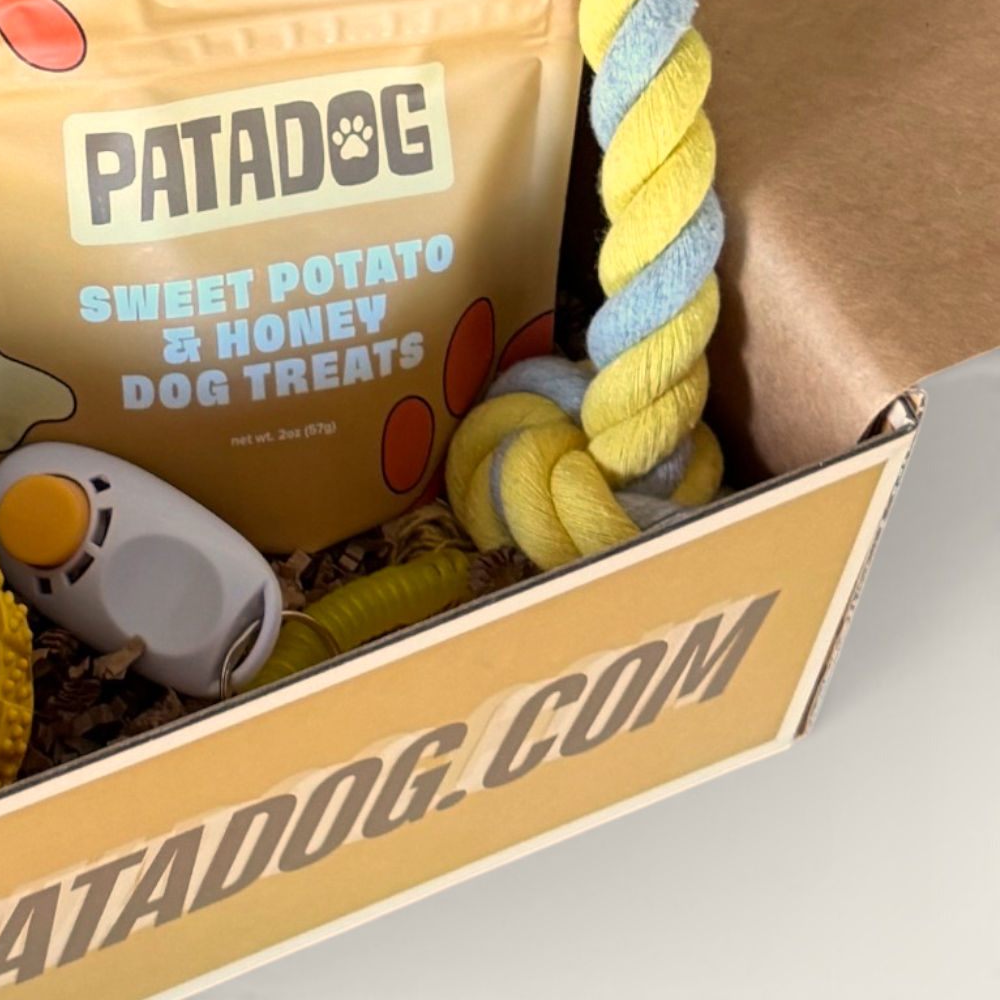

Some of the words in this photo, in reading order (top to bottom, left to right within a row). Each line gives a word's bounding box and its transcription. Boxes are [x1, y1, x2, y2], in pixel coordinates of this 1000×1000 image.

[85, 83, 434, 226] PATADOG
[78, 268, 254, 323] SWEET
[267, 234, 455, 303] POTATO
[162, 326, 201, 365] &
[216, 294, 388, 360] HONEY
[121, 368, 230, 411] DOG
[243, 331, 425, 401] TREATS
[230, 434, 253, 447] net
[278, 428, 302, 441] 2oz
[304, 420, 337, 438] (57g)
